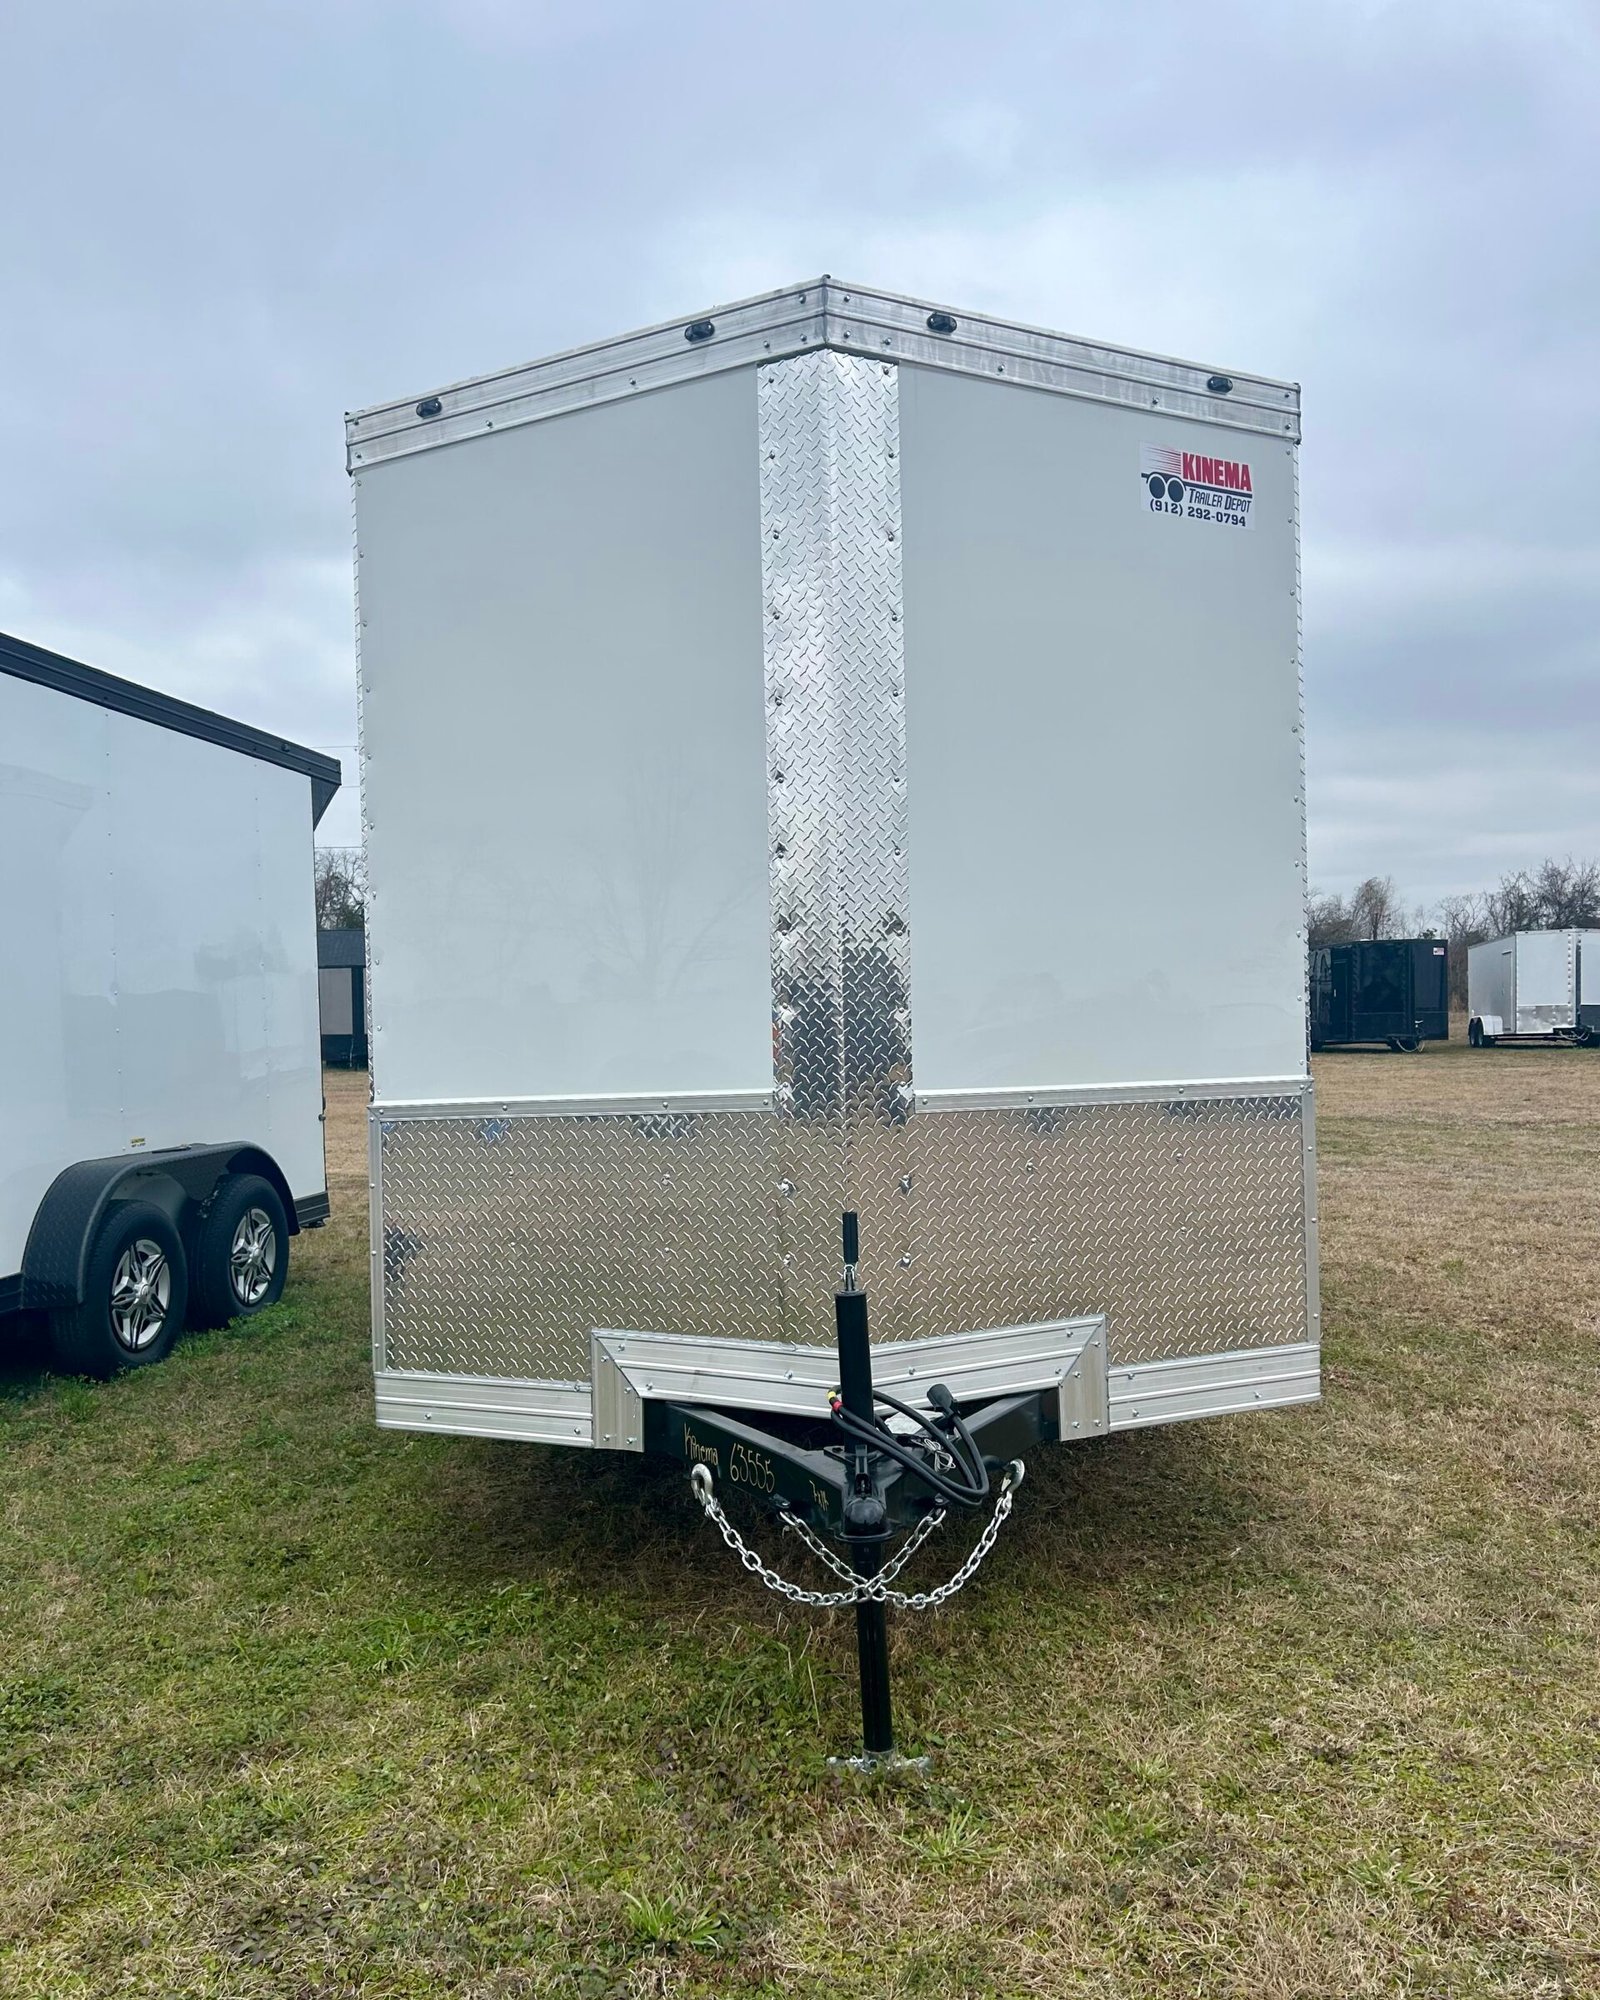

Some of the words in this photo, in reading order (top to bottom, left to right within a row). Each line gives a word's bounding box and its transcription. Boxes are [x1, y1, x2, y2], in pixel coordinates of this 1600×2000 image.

[1182, 452, 1252, 492] KINEMA
[1150, 499, 1183, 517] (912)
[1187, 506, 1246, 527] 292-0794
[730, 1443, 775, 1493] 63555
